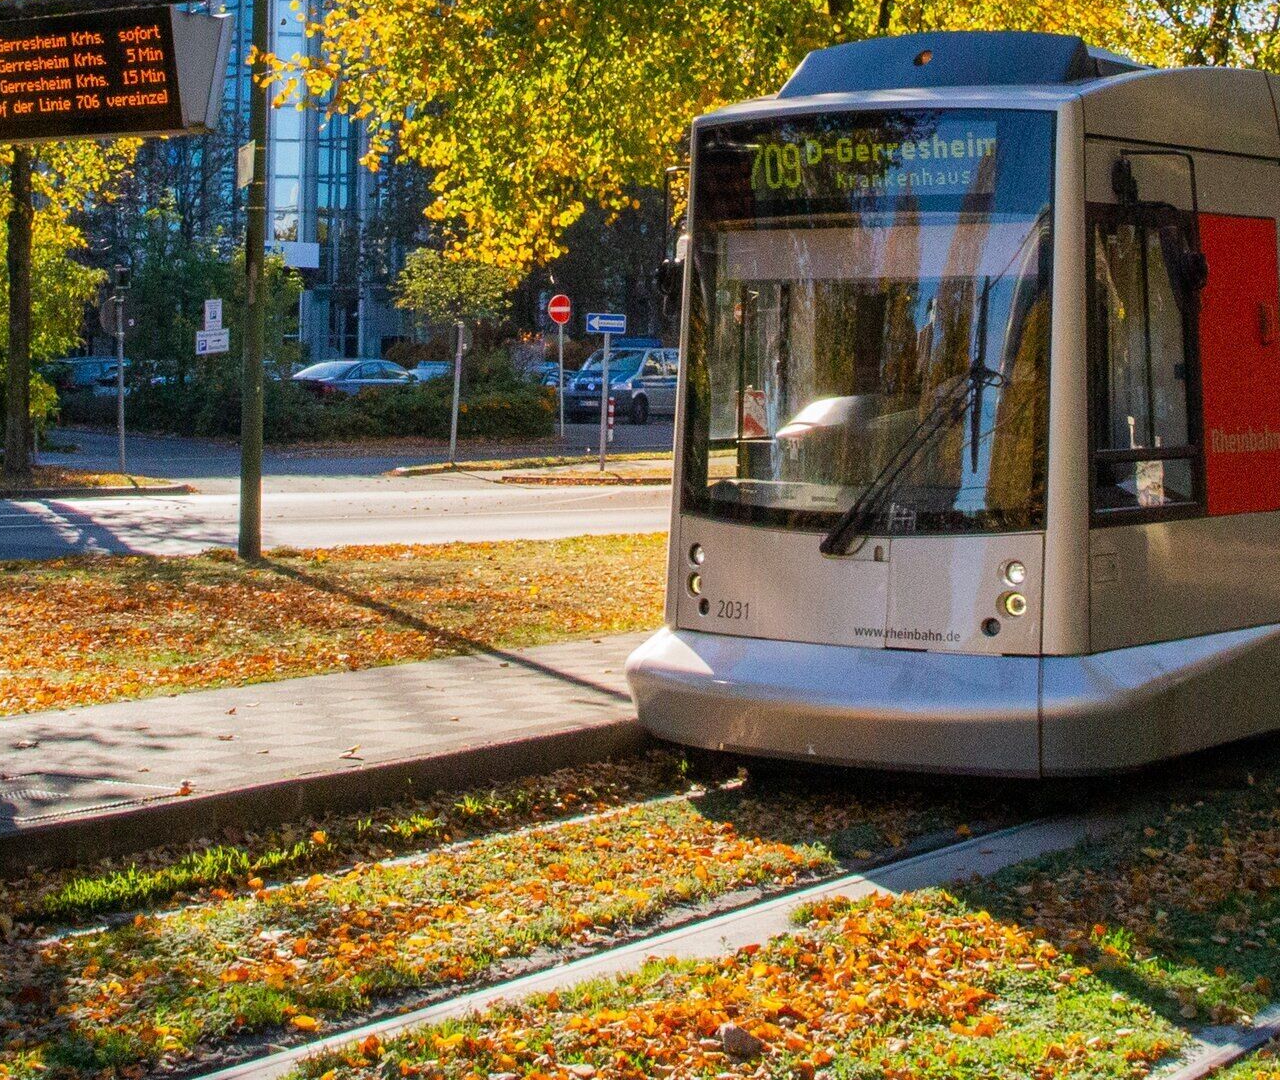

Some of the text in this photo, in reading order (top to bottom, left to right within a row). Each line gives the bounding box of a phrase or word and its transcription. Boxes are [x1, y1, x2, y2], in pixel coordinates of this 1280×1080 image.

[71, 31, 105, 46] Krhs.
[118, 24, 161, 44] sofort
[74, 52, 107, 66] Krhs.
[127, 49, 136, 63] 5
[138, 47, 163, 61] Min
[0, 78, 71, 94] Gerresheim
[76, 73, 109, 87] Krhs.
[122, 71, 139, 85] 15
[141, 69, 166, 83] Min
[14, 98, 34, 114] der
[39, 96, 71, 111] Linie
[76, 95, 100, 109] 706
[106, 90, 168, 108] vereinzel
[750, 143, 803, 190] 709
[836, 167, 971, 189] Krankenhaus
[1211, 425, 1280, 453] Rheinbahn
[716, 600, 749, 621] 2031
[854, 624, 961, 642] www.rheinbahn.de
